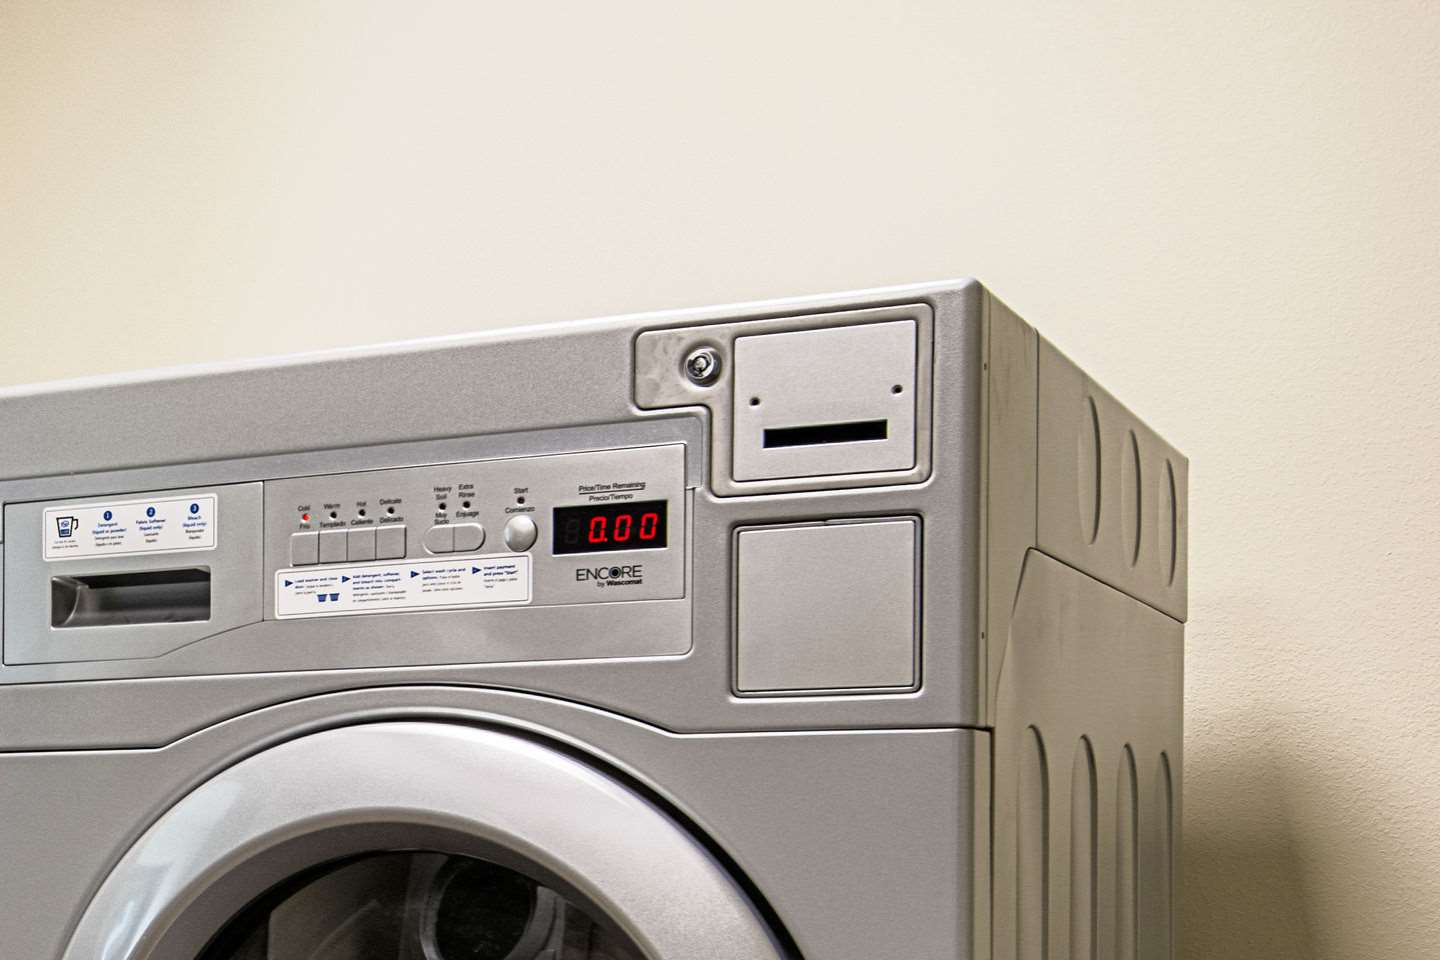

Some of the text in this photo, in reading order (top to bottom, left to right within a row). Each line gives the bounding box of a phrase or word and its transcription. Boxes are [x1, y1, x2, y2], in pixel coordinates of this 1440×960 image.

[578, 482, 646, 492] Price/Time Remaining
[589, 493, 633, 501] Precio/Tiempo
[588, 512, 658, 543] 0.00
[576, 565, 643, 581] ENCORE
[606, 579, 642, 587] Wascomat
